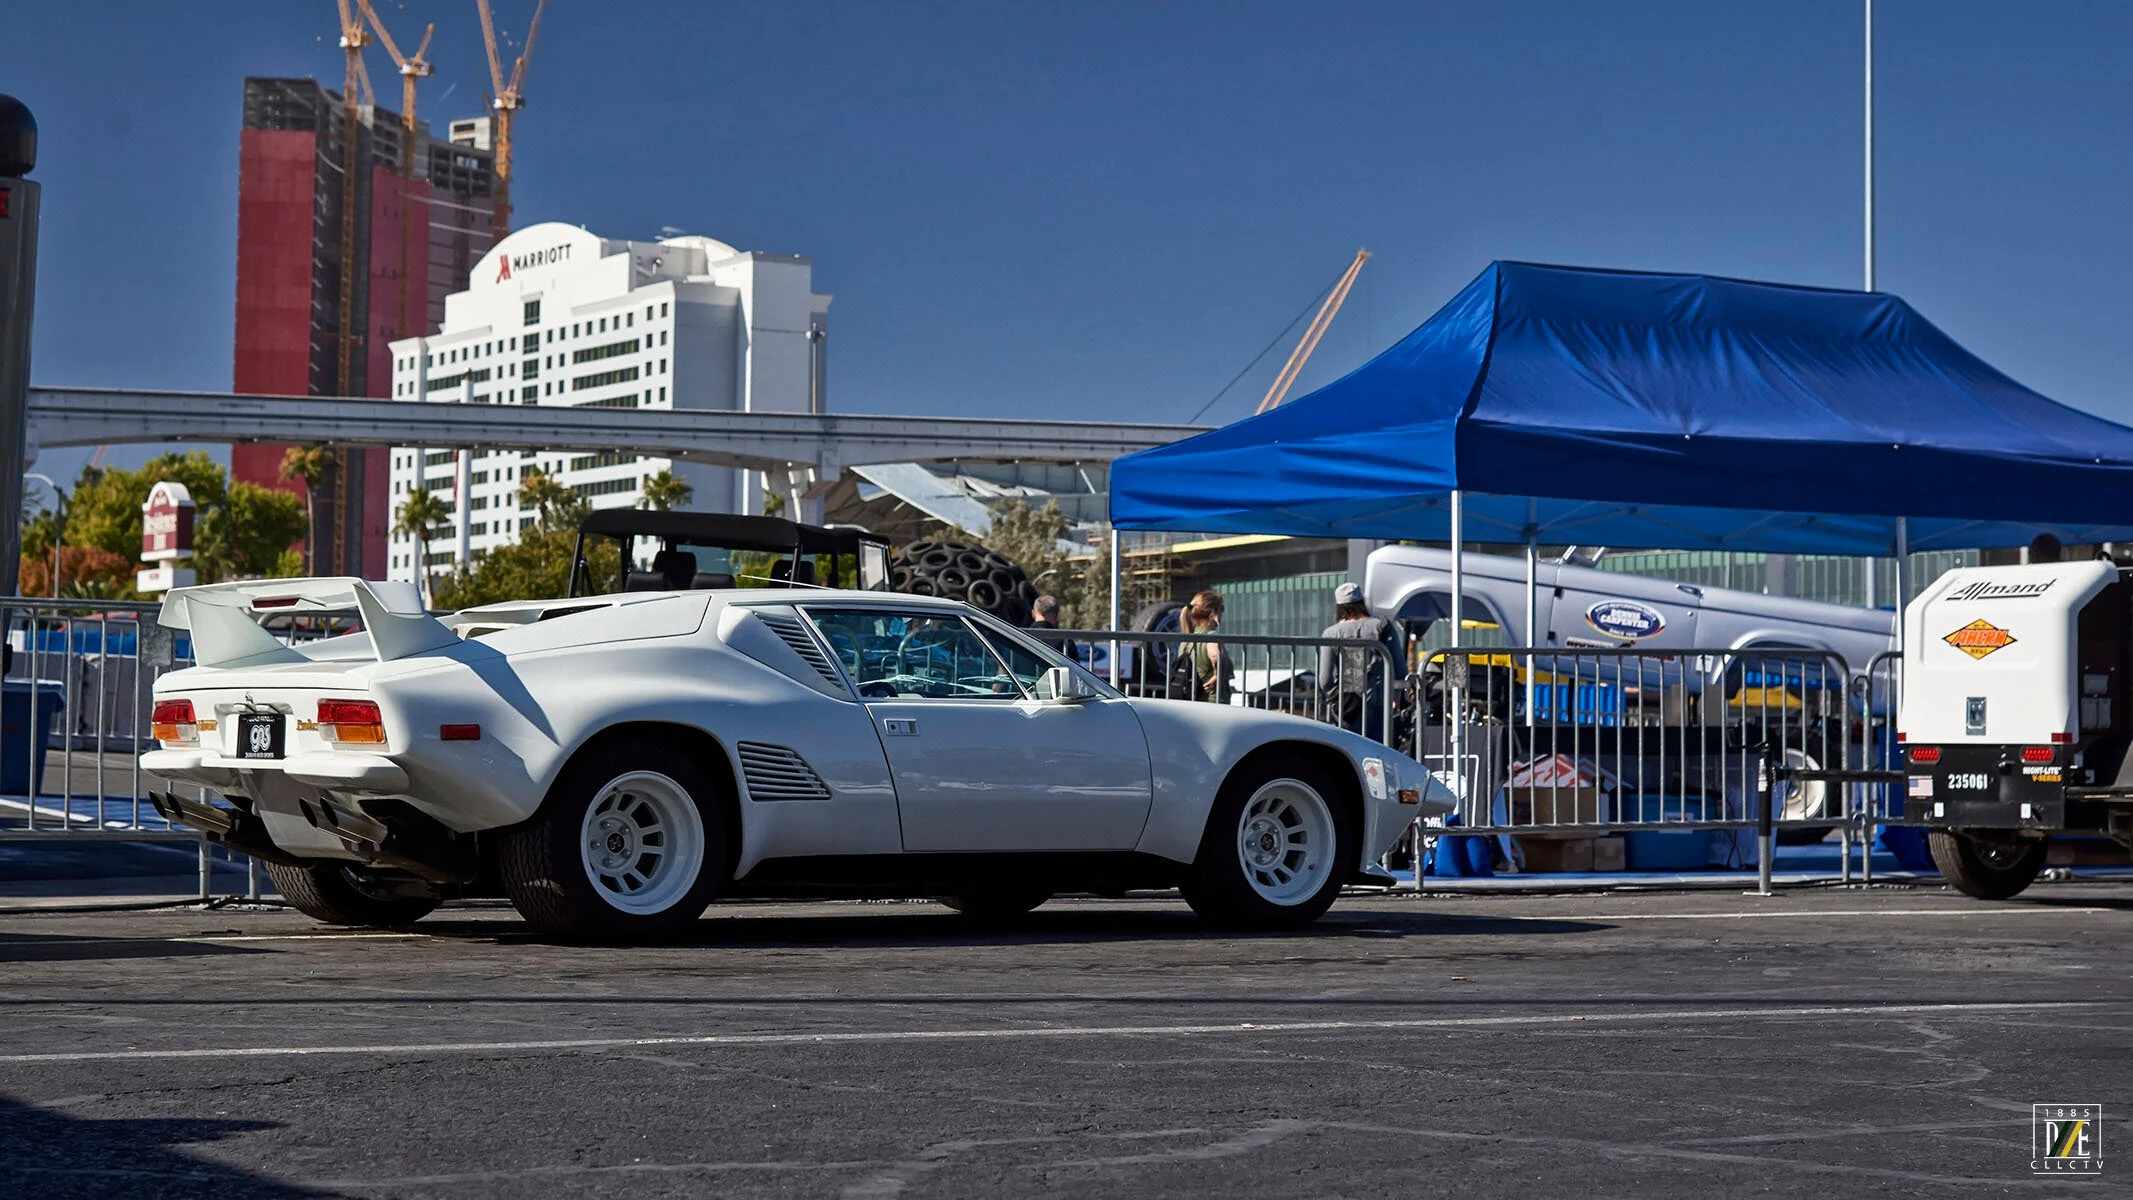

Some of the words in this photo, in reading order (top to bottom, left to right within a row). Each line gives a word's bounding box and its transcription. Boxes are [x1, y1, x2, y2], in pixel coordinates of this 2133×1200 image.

[513, 244, 571, 272] MARRIOTT
[1953, 579, 2057, 600] Allmand
[1601, 614, 1650, 629] CARPENTER
[1948, 774, 1988, 789] 235061
